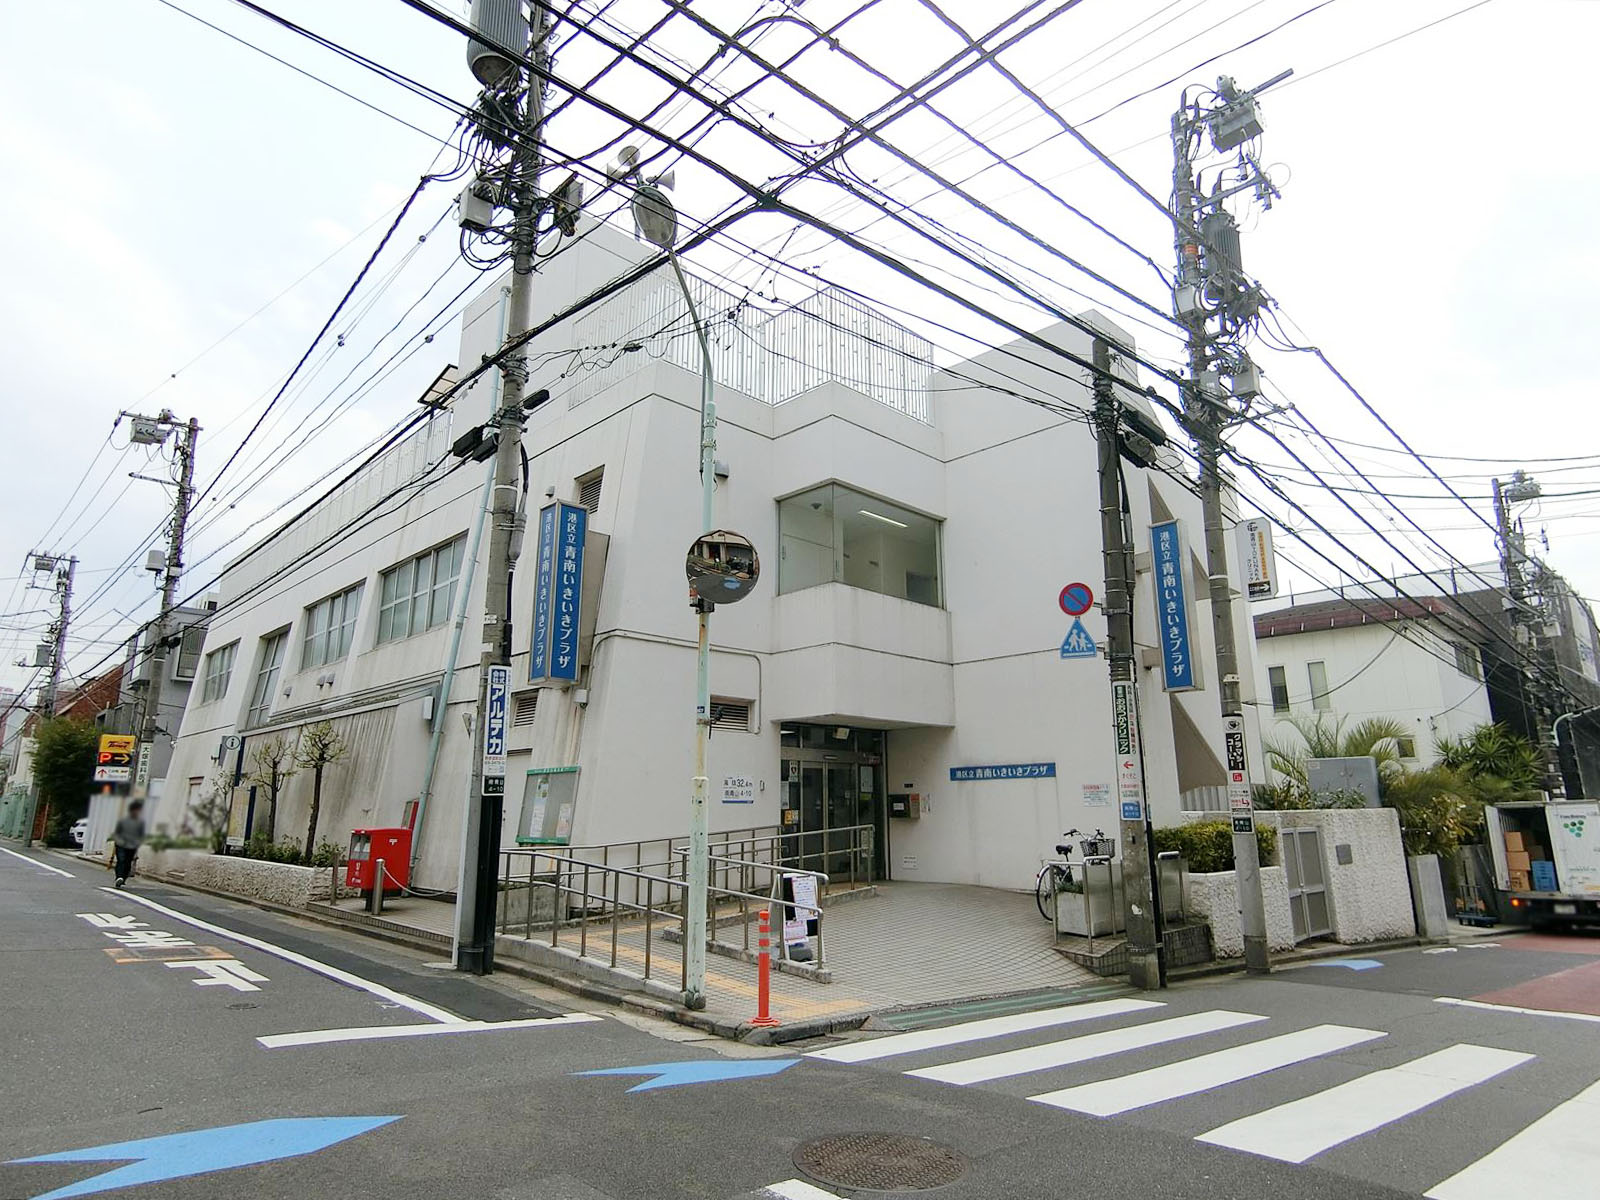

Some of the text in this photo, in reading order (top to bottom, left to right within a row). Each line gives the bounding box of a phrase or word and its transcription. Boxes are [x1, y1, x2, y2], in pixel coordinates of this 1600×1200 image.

[536, 513, 552, 669] 港区立青南いきいきプラザ
[558, 511, 577, 669] 港区立青南いきいきプラザ
[1160, 531, 1185, 678] 港区立青南いきいきプラザ
[99, 753, 112, 763] P
[489, 684, 505, 754] アルテカ
[955, 765, 1048, 779] 港区立青南いきいきプラザ
[75, 913, 271, 991] 止まれ
